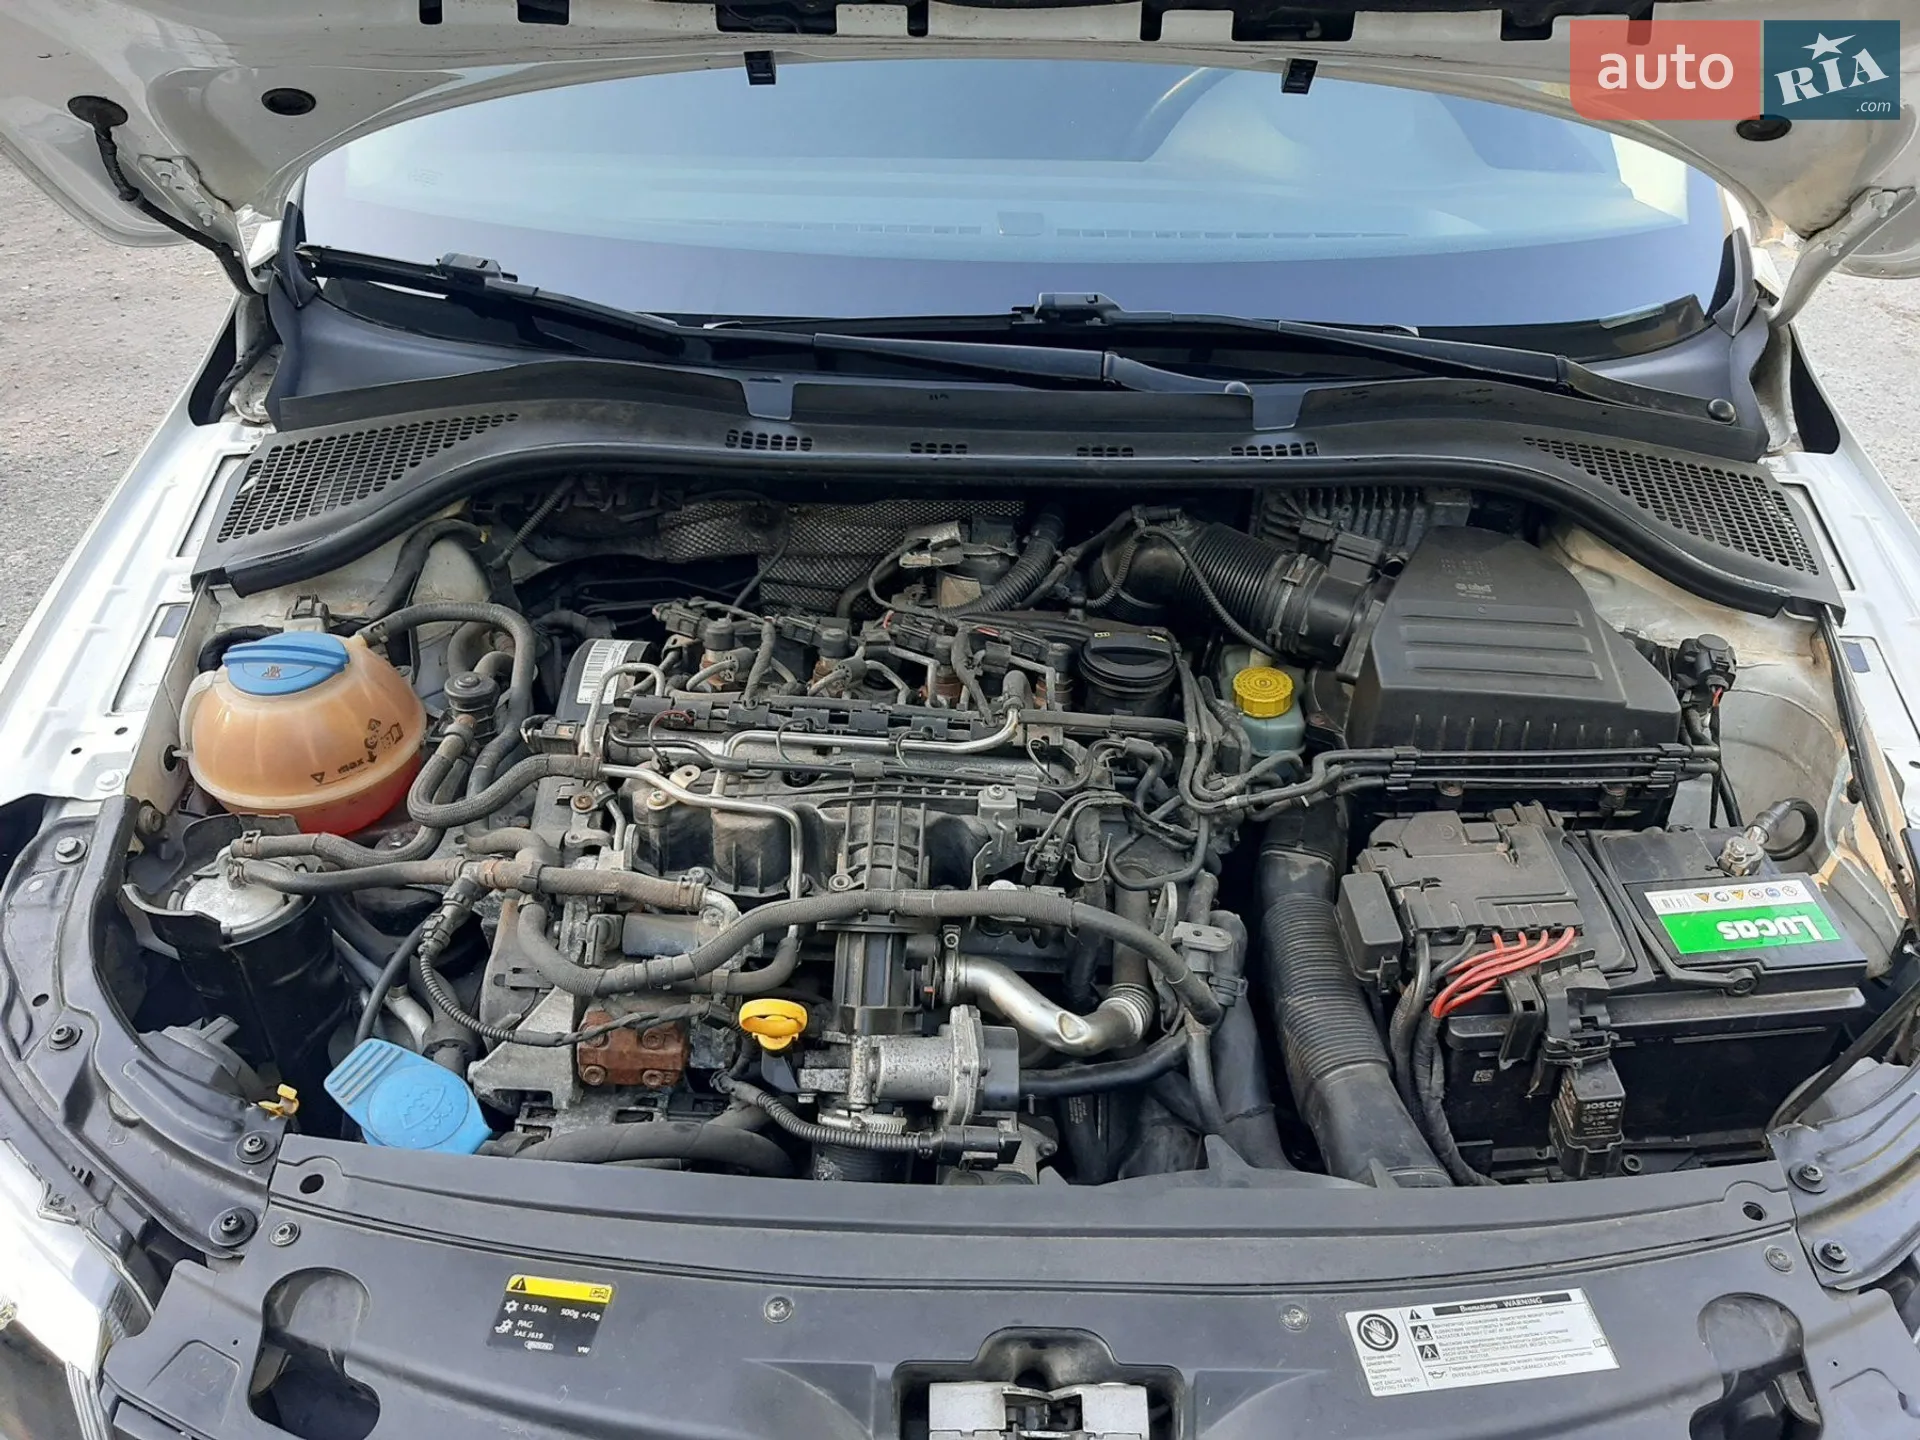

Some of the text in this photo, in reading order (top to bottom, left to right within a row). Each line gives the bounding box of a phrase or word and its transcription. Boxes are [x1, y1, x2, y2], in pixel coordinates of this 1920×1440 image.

[337, 758, 364, 774] max
[1716, 915, 1823, 941] Lucas
[1502, 1297, 1542, 1308] WARNING
[523, 1304, 548, 1313] R-134a
[560, 1308, 579, 1319] 500g
[517, 1320, 534, 1328] PAG
